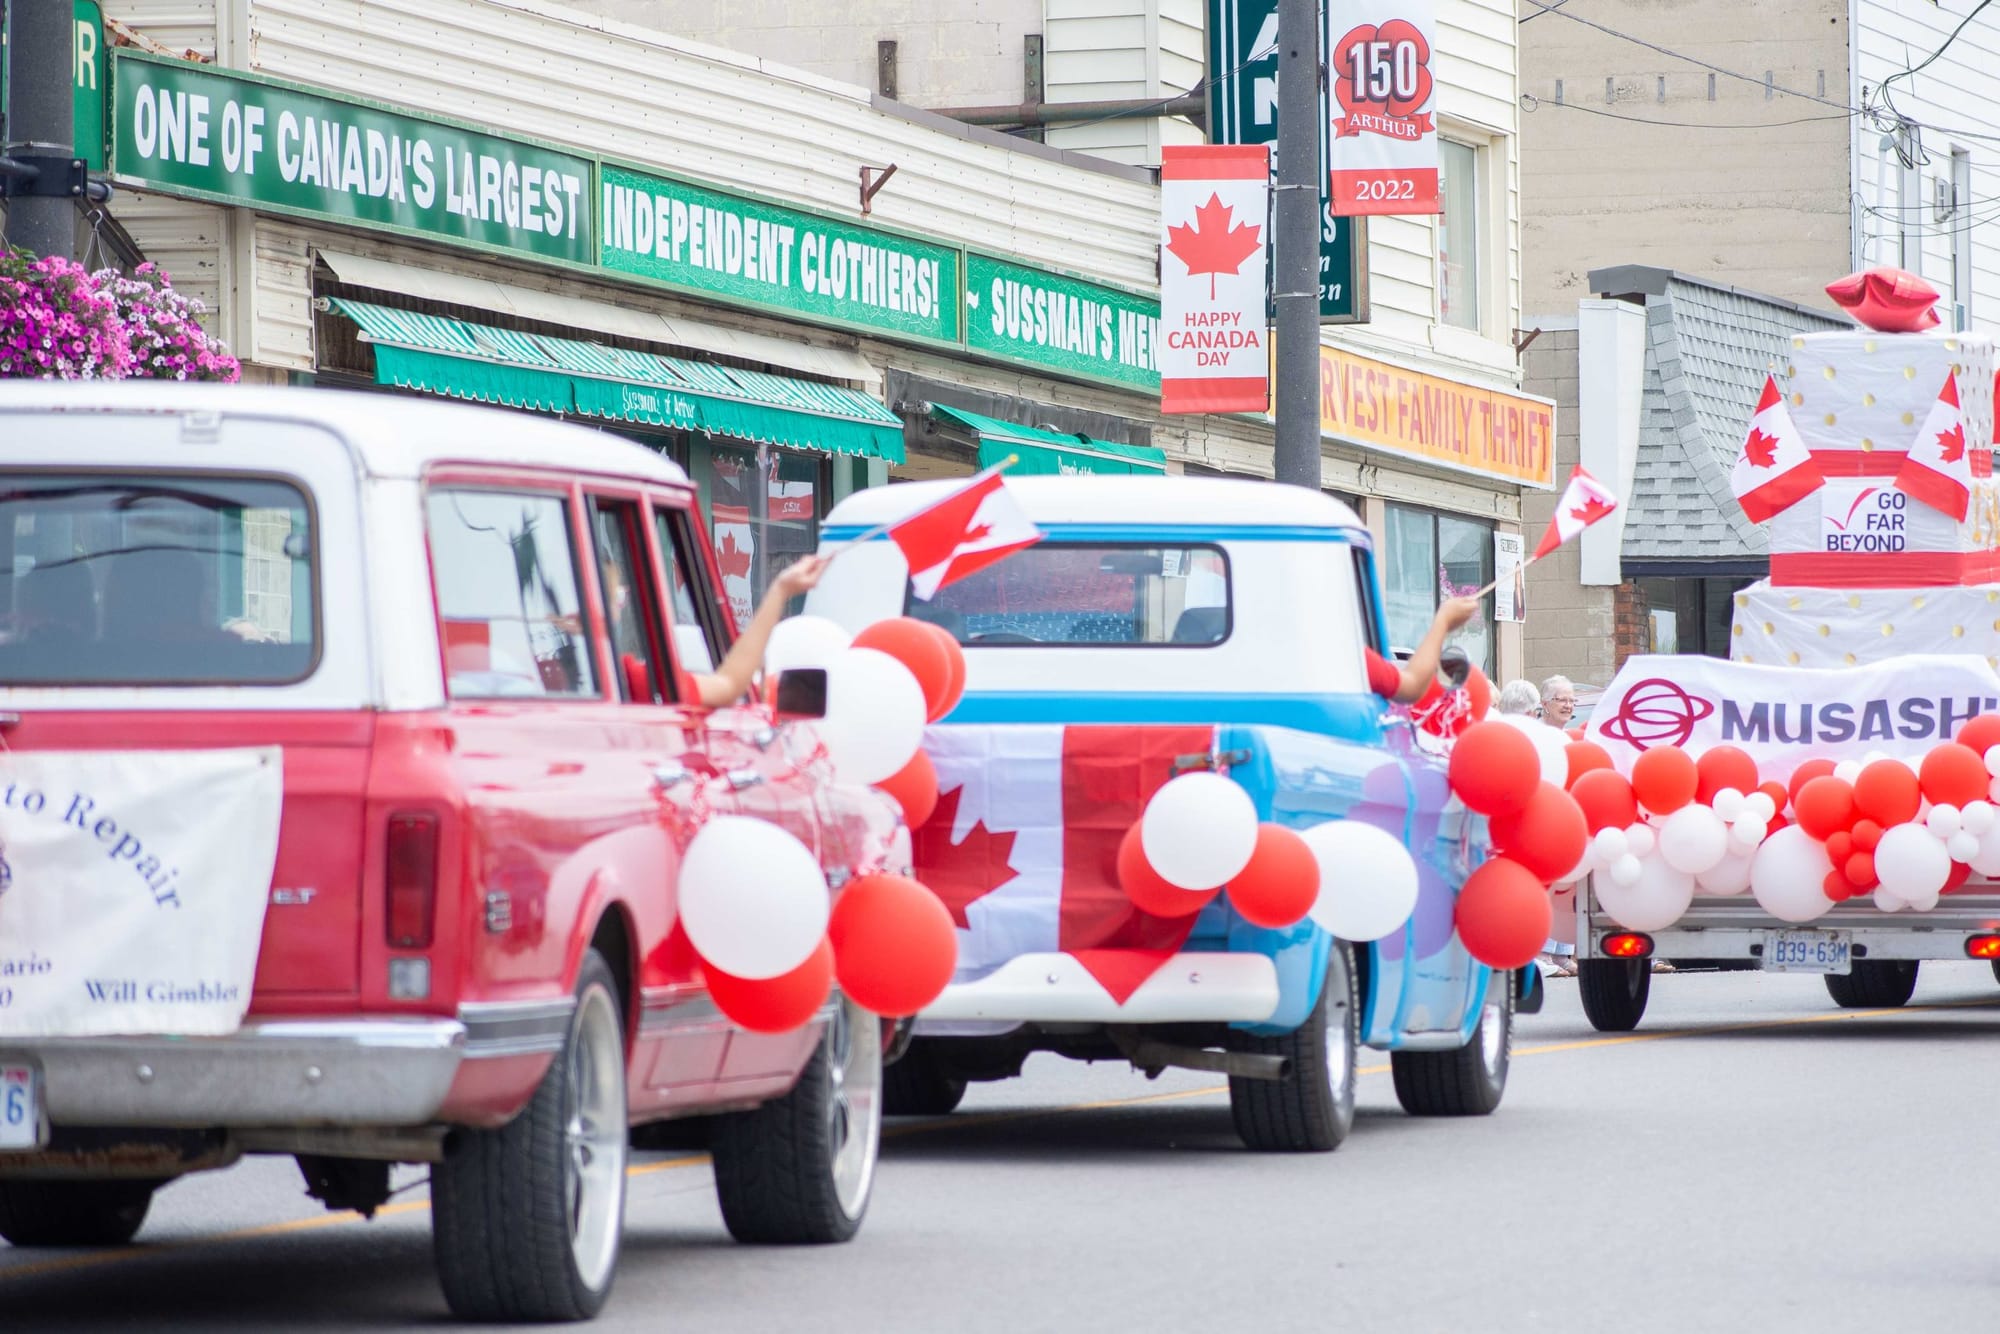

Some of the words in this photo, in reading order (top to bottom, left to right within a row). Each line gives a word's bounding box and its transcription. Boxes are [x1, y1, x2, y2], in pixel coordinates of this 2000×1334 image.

[73, 19, 96, 90] R
[1346, 40, 1419, 103] 150
[1350, 112, 1418, 137] ARTHUR
[134, 84, 209, 166] ONE
[221, 100, 264, 174] OF
[277, 110, 435, 210] CANADA'S
[445, 146, 580, 239] LARGEST
[1356, 180, 1415, 200] 2022
[604, 182, 794, 288] INDEPENDENT
[800, 231, 939, 319] CLOTHIERS!
[991, 277, 1112, 361] SUSSMAN'S
[1185, 312, 1241, 326] HAPPY
[1168, 331, 1260, 349] CANADA
[1197, 352, 1230, 366] DAY
[1397, 380, 1475, 455] FAMILY
[1479, 400, 1550, 473] THRIFT
[1878, 492, 1906, 510] GO
[1867, 513, 1904, 530] FAR
[1827, 534, 1905, 551] BEYOND
[1721, 697, 1998, 744] MUSASH
[63, 793, 182, 909] Repair
[85, 979, 137, 1003] Will
